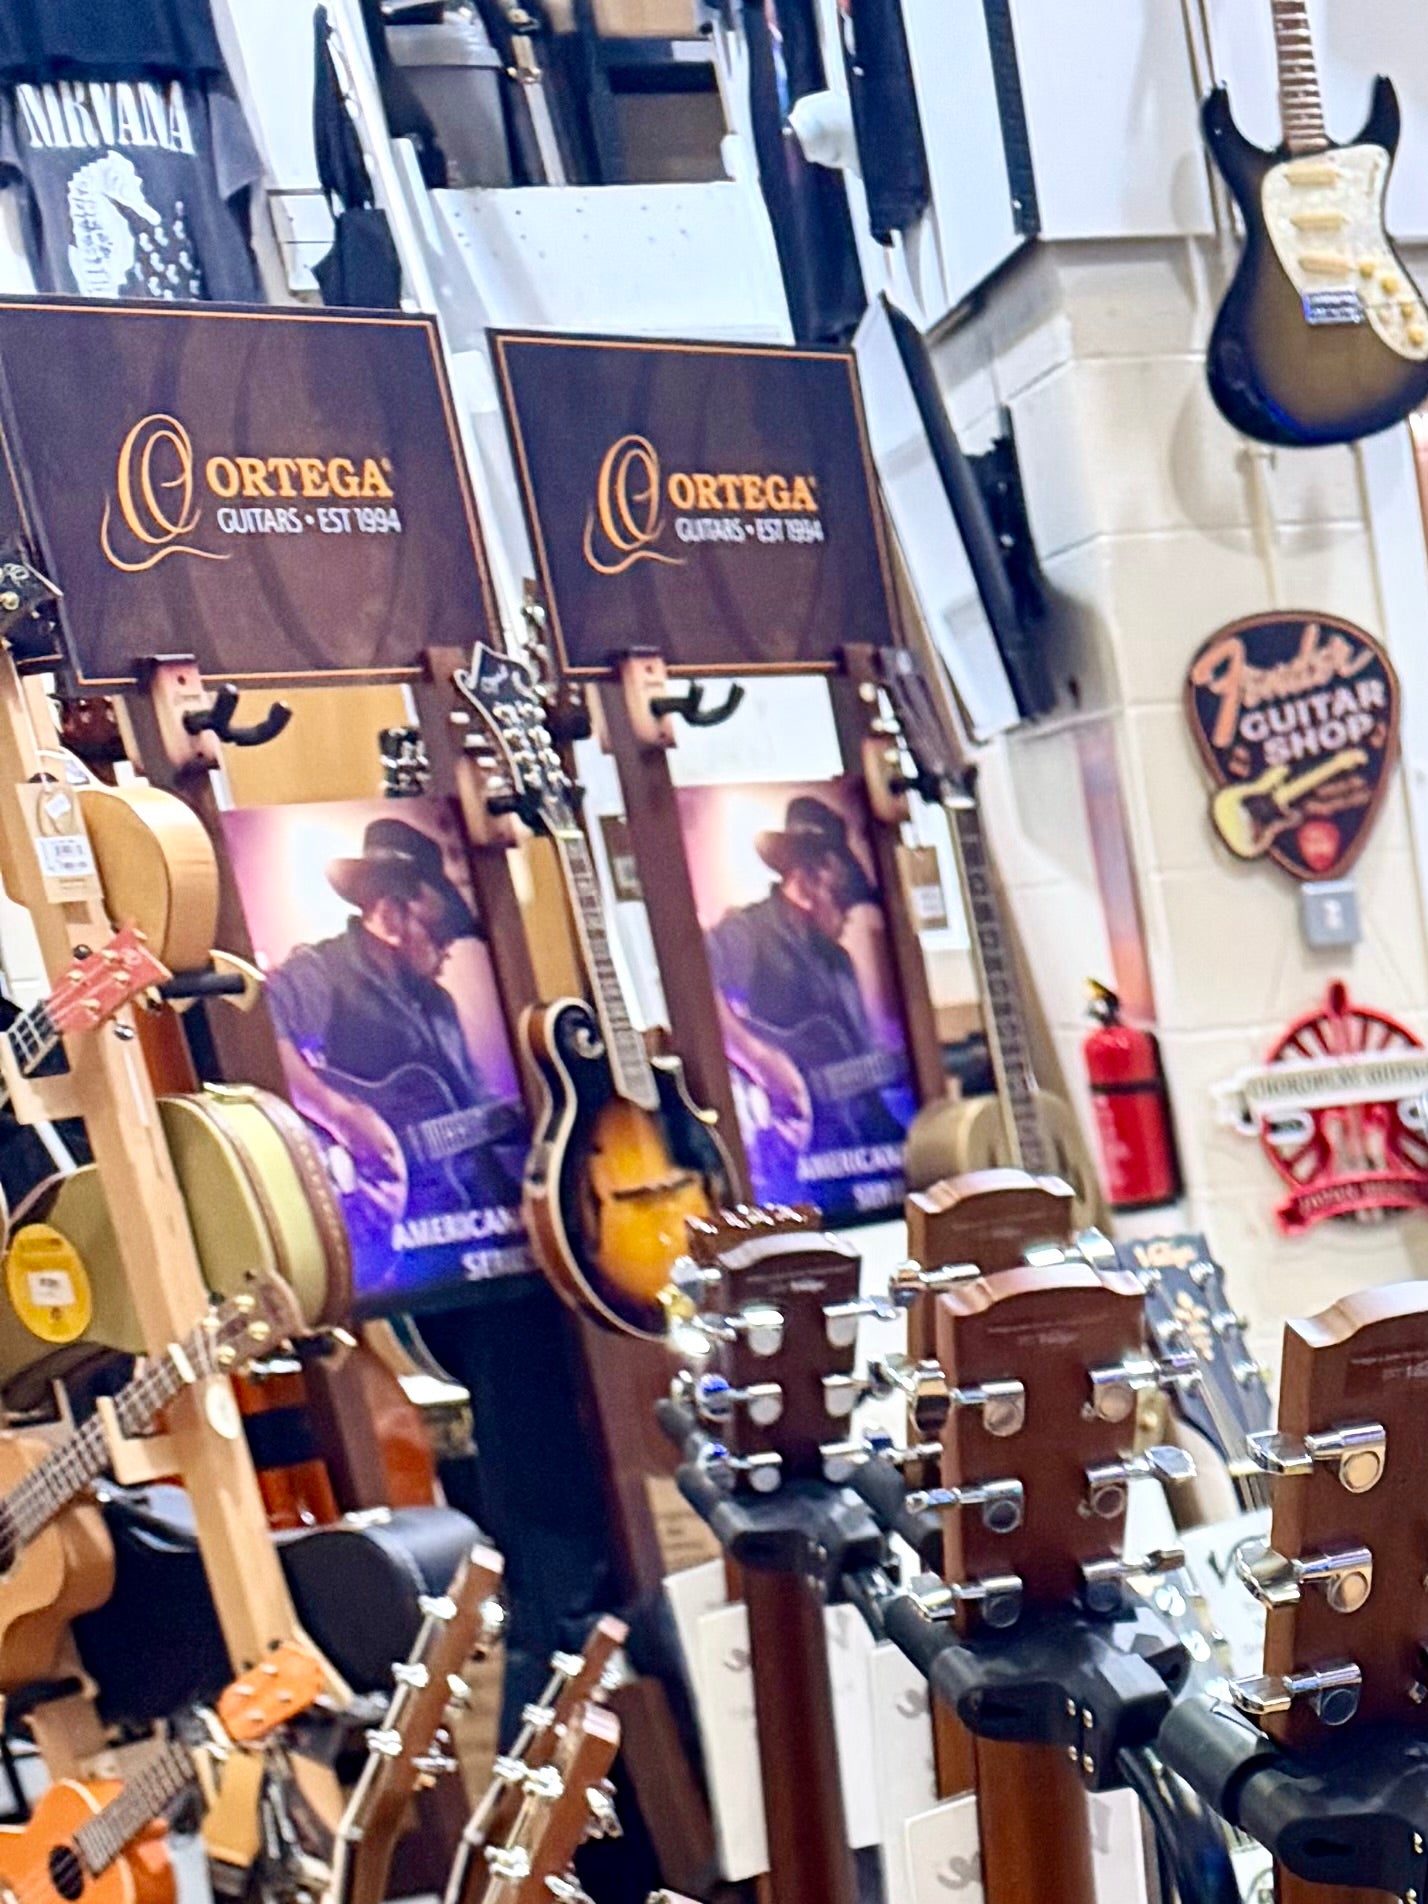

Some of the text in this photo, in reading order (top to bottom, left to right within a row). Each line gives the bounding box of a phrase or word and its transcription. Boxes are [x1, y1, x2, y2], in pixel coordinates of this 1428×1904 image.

[16, 81, 196, 154] NIRVANA
[205, 455, 394, 498] ORTEGA
[667, 472, 819, 513] ORTEGA
[216, 507, 403, 534] GUITARS EST 1994
[1190, 623, 1378, 748] Fender
[1239, 679, 1386, 742] GUITAR
[1263, 713, 1376, 767] SHOP
